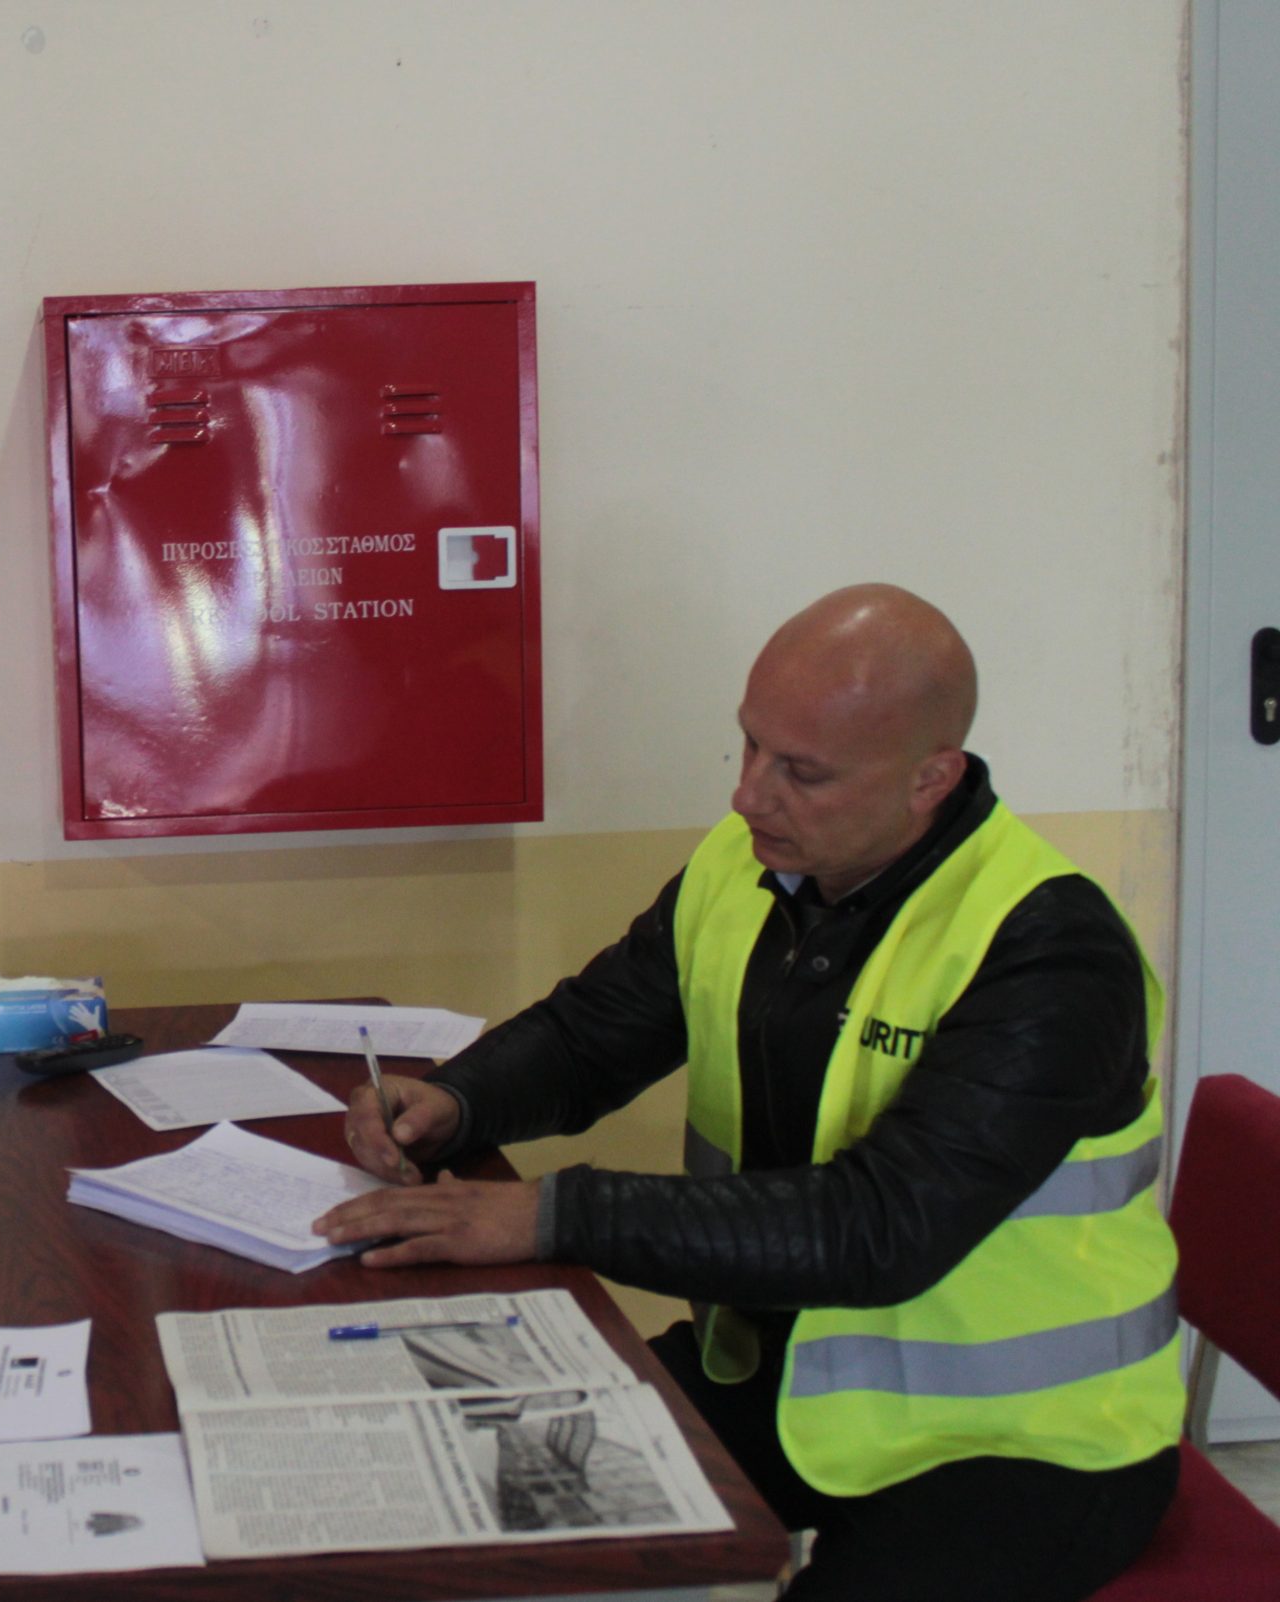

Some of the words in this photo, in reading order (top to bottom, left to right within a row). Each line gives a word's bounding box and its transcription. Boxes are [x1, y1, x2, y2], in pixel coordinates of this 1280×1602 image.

[161, 537, 324, 562] ΠΥΡΟΣΚΟΣ
[325, 533, 417, 556] ΣΤΑΘΜΟΣ
[239, 602, 302, 624] OOL
[313, 598, 415, 621] STATION
